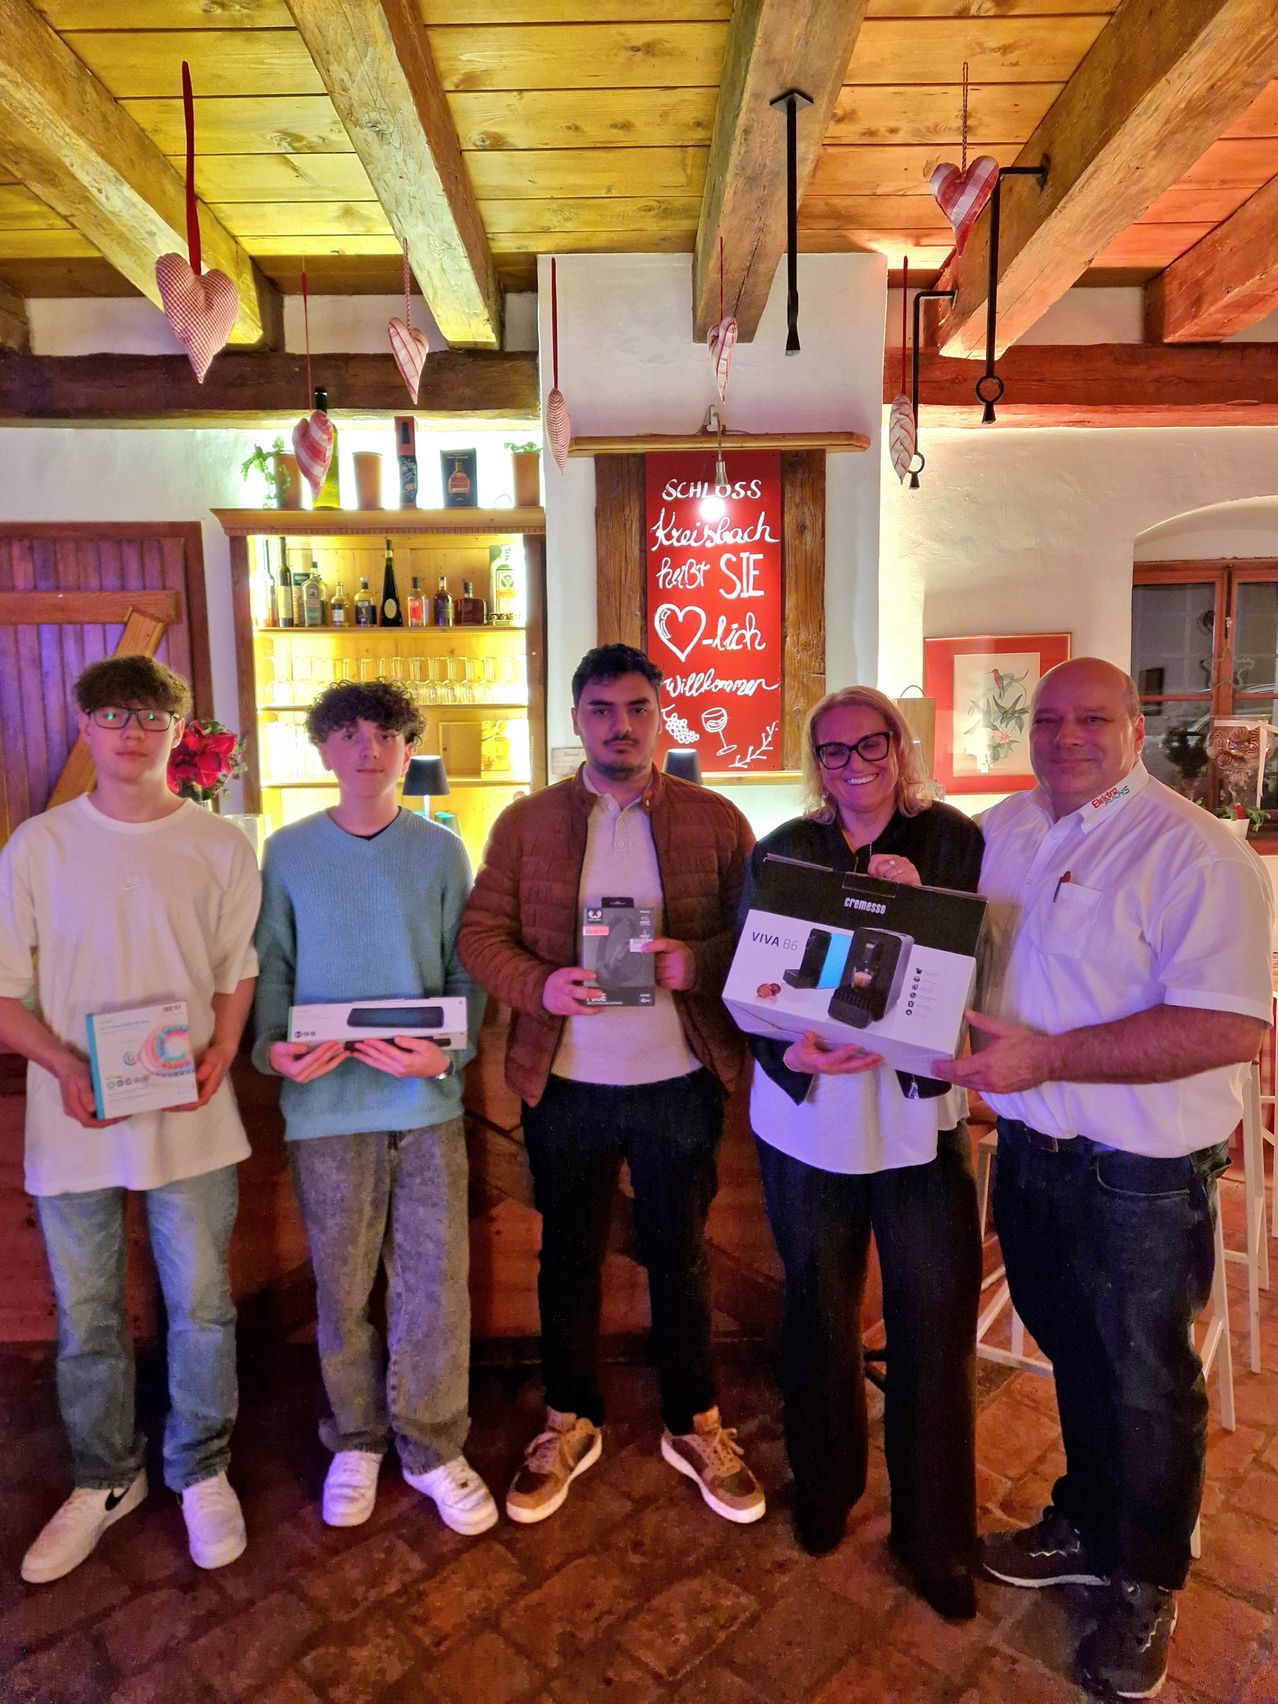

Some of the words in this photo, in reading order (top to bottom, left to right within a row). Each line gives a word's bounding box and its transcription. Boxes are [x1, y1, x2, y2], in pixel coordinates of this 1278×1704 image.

[662, 478, 762, 501] SCHLOSS
[649, 507, 780, 551] Kreisbach
[656, 557, 711, 590] heißt
[719, 552, 764, 599] SIE
[1091, 787, 1118, 808] Elektro
[844, 896, 886, 915] cremesso
[752, 931, 779, 947] VIVA
[783, 938, 799, 951] B6
